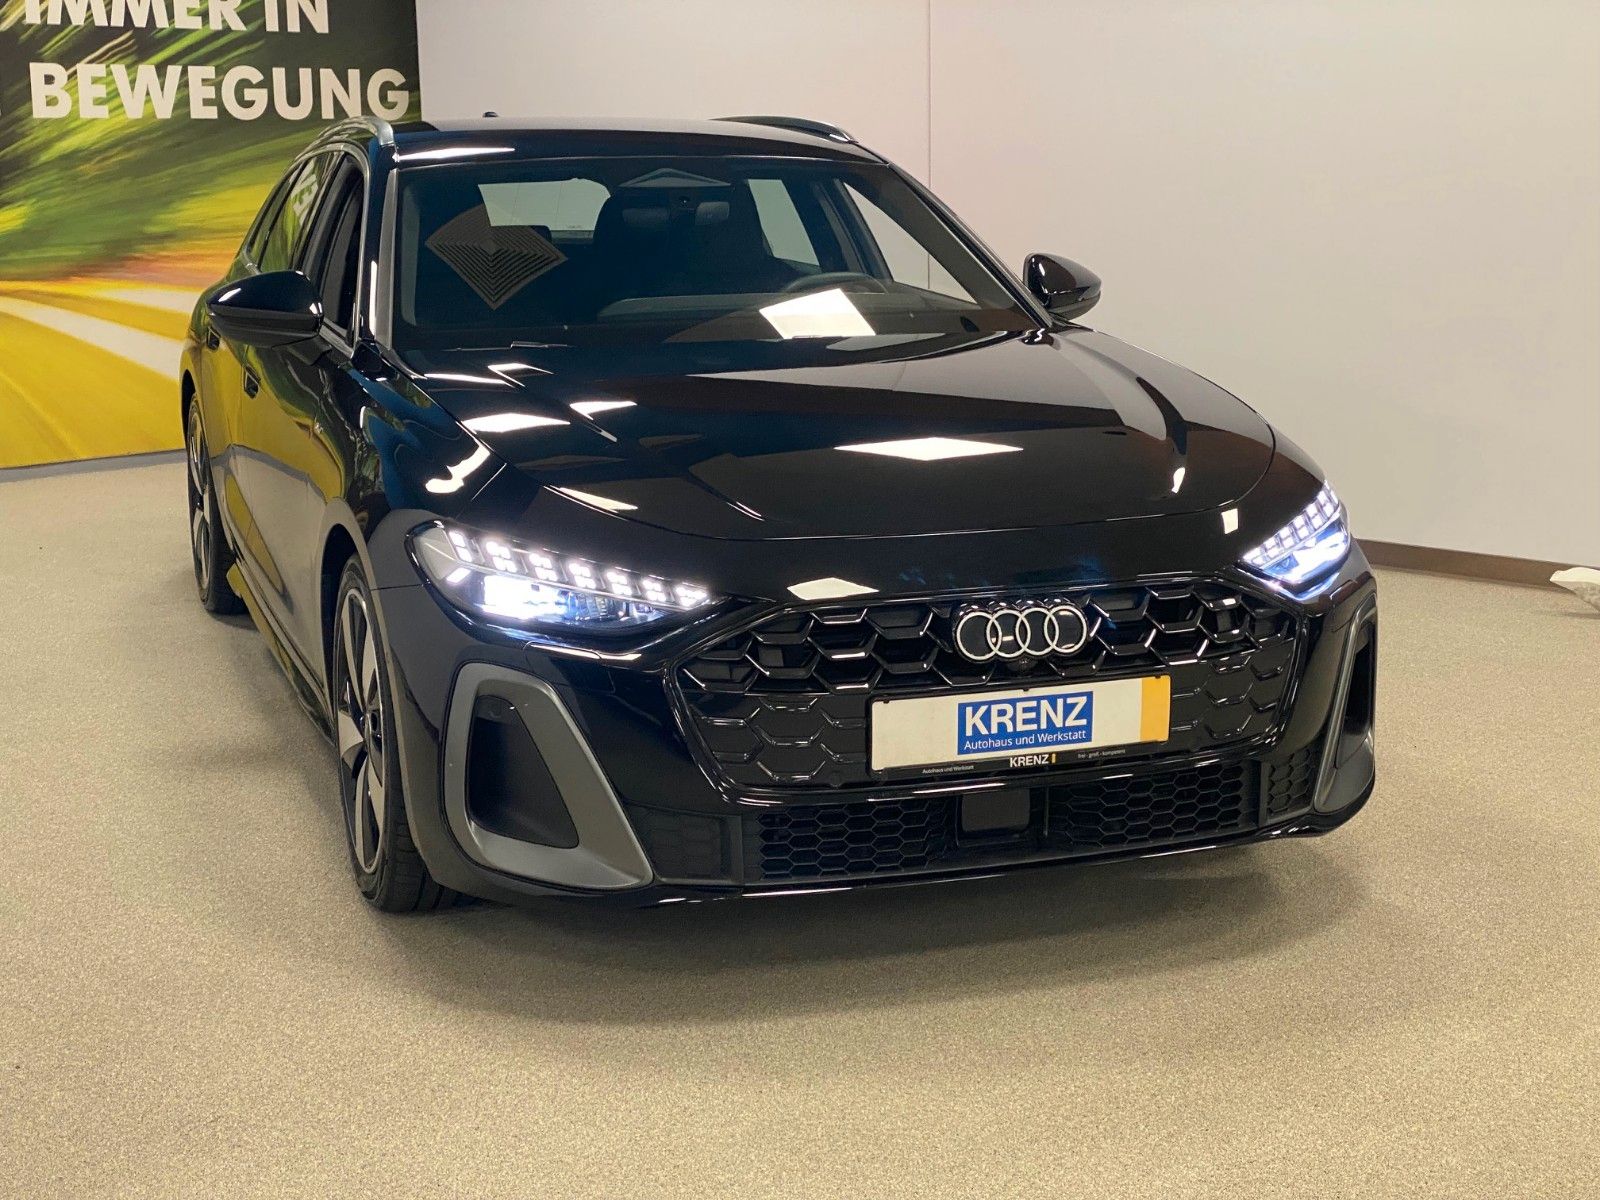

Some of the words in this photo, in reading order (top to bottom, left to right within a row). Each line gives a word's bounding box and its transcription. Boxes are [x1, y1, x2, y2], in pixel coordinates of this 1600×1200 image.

[264, 0, 329, 33] IN
[29, 62, 409, 120] BEWEGUNG
[965, 696, 1088, 736] KRENZ
[964, 738, 1013, 750] Autohaus
[1015, 734, 1035, 745] und
[1038, 730, 1086, 743] Werkstatt
[1009, 753, 1050, 768] KRENZ
